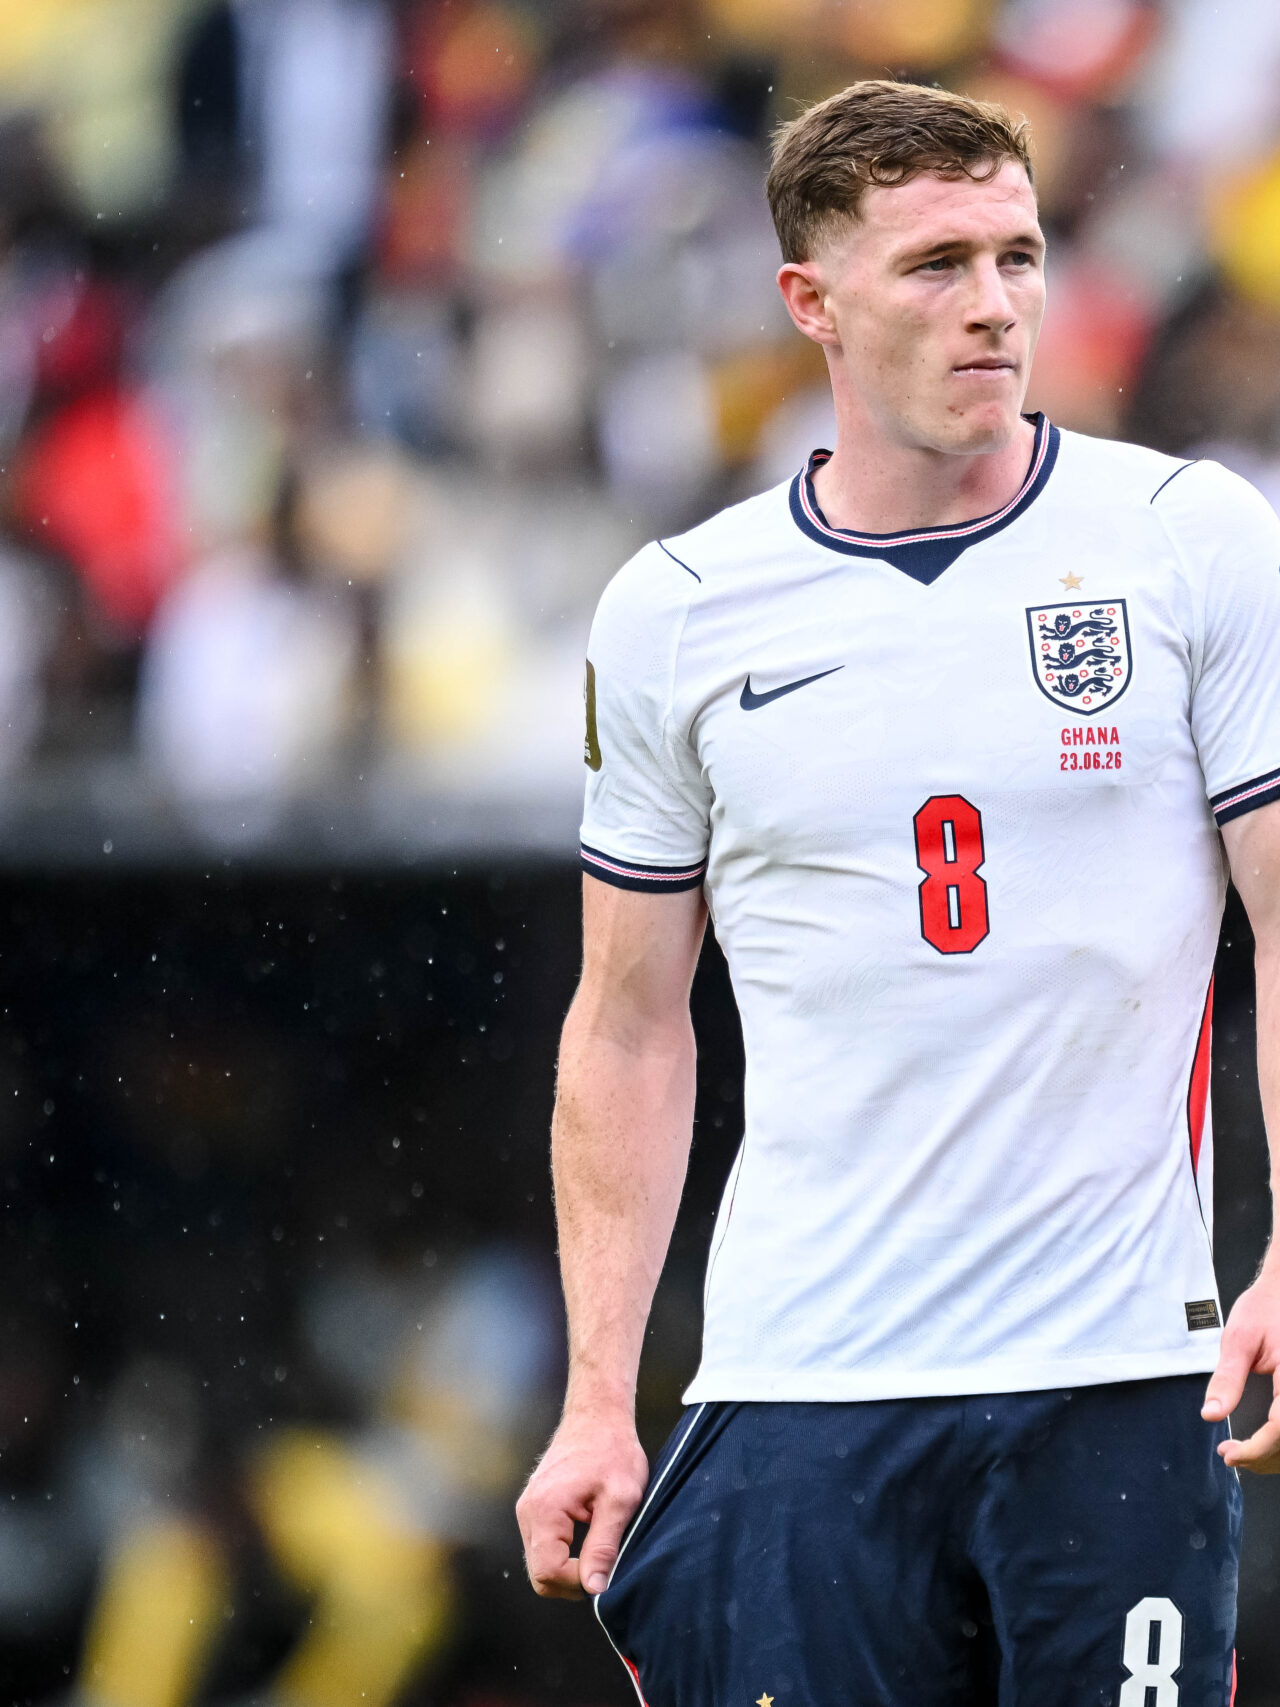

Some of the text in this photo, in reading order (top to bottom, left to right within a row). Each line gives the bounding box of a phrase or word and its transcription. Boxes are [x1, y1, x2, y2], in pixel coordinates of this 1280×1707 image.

[1060, 752, 1122, 771] 23.06.26
[1061, 727, 1120, 746] GHANA
[912, 794, 990, 955] 8
[1119, 1596, 1184, 1707] 8
